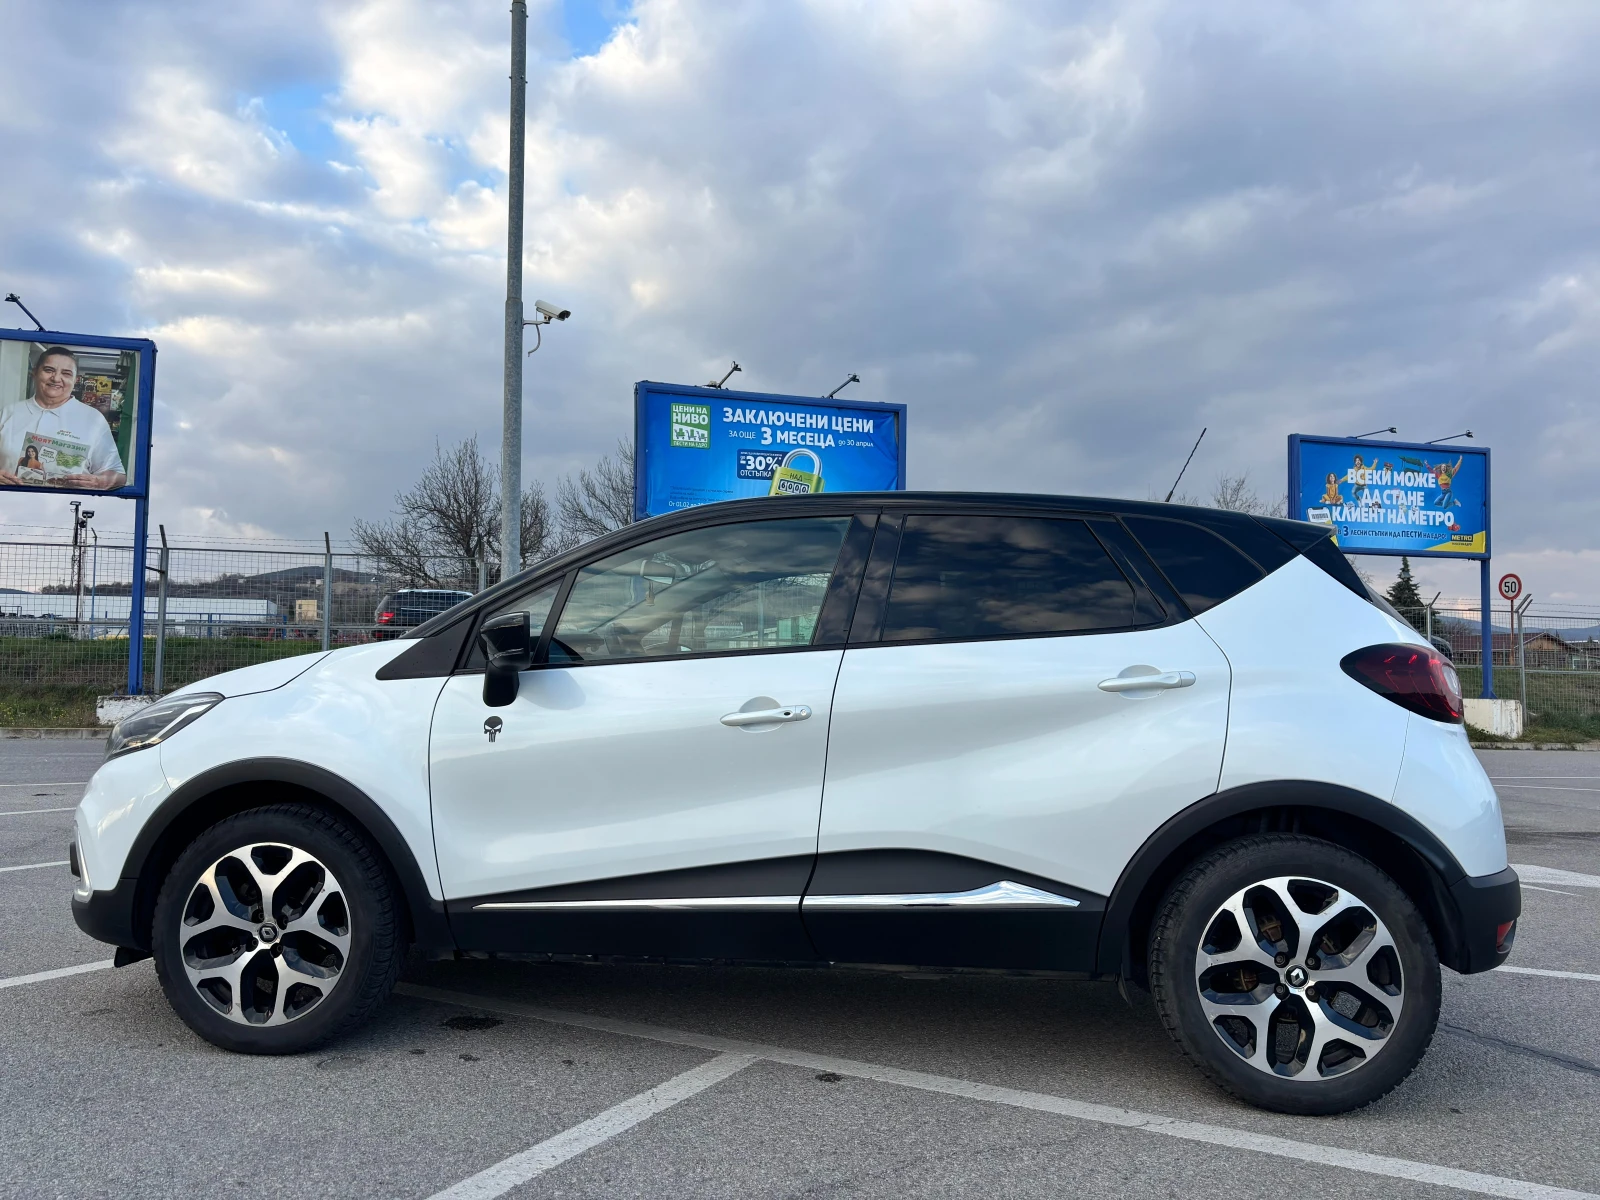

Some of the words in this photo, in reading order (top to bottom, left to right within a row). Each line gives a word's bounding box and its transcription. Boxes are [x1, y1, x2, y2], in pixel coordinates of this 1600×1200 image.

[673, 405, 695, 413] ЦЕНИ
[696, 406, 707, 414] НА
[673, 413, 708, 425] НИВО
[723, 407, 829, 430] ЗАКЛЮЧЕНИ
[831, 416, 874, 434] ЦЕНИ
[728, 430, 738, 438] ЗА
[739, 430, 756, 439] ОЩЕ
[761, 427, 773, 445] 3
[776, 430, 836, 449] МЕСЕЦА
[846, 439, 855, 447] 30
[855, 440, 874, 448] април
[740, 469, 772, 478] ОТСТЪПКА
[789, 472, 803, 482] НАД
[1347, 468, 1392, 486] ВСЕКИ
[1393, 471, 1436, 488] МОЖЕ
[1361, 488, 1381, 507] ДА
[1382, 489, 1425, 507] СТАНЕ
[1332, 505, 1386, 523] КЛИЕНТ
[1387, 508, 1407, 525] НА
[1408, 509, 1455, 527] МЕТРО
[1343, 525, 1349, 537] 3
[1368, 529, 1388, 537] СТЪПКИ
[1393, 531, 1400, 539] ДА
[1401, 530, 1422, 538] ПЕСТИ
[1504, 581, 1517, 593] 50
